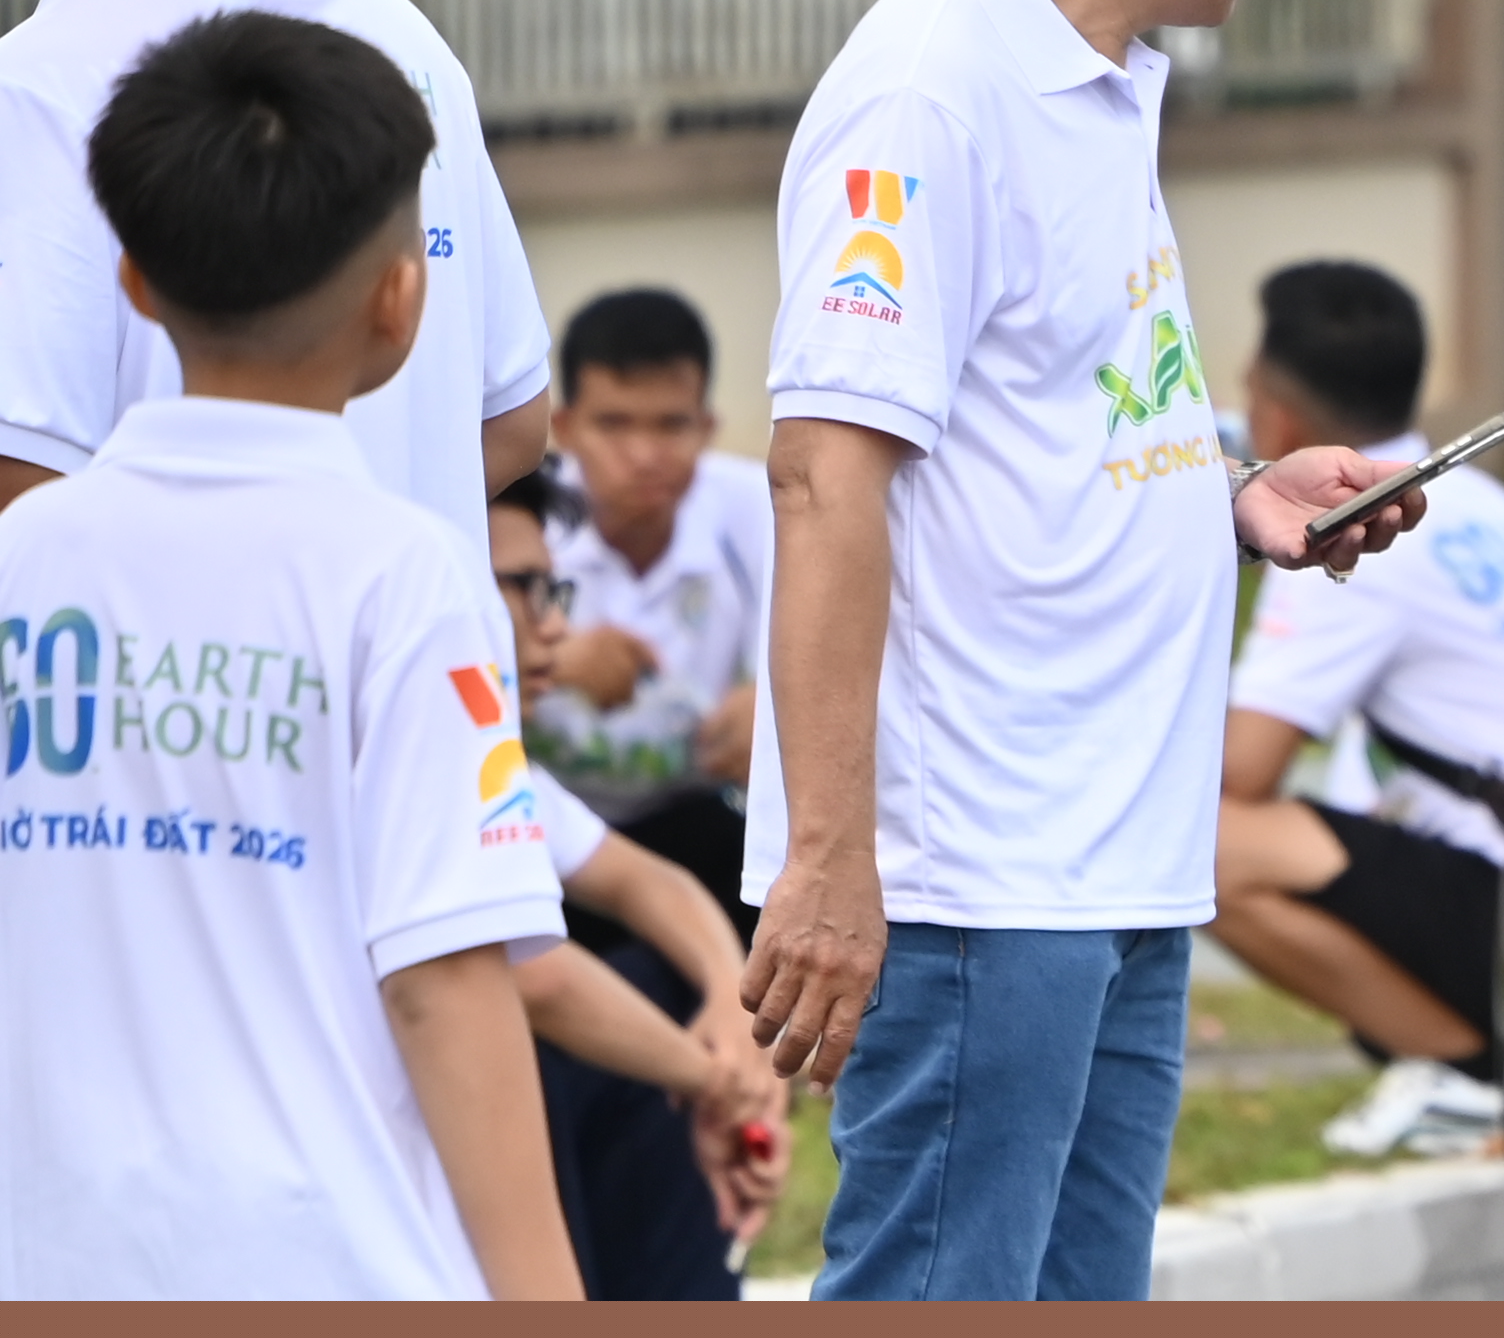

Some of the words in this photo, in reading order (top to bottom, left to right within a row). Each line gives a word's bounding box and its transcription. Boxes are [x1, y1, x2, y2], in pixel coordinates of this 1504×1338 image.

[847, 300, 903, 326] SOLAR
[113, 633, 330, 715] EARTH
[112, 694, 304, 773] HOUR
[41, 804, 126, 848] TRÁI
[143, 808, 217, 855] ĐẤT
[230, 823, 305, 870] 2026
